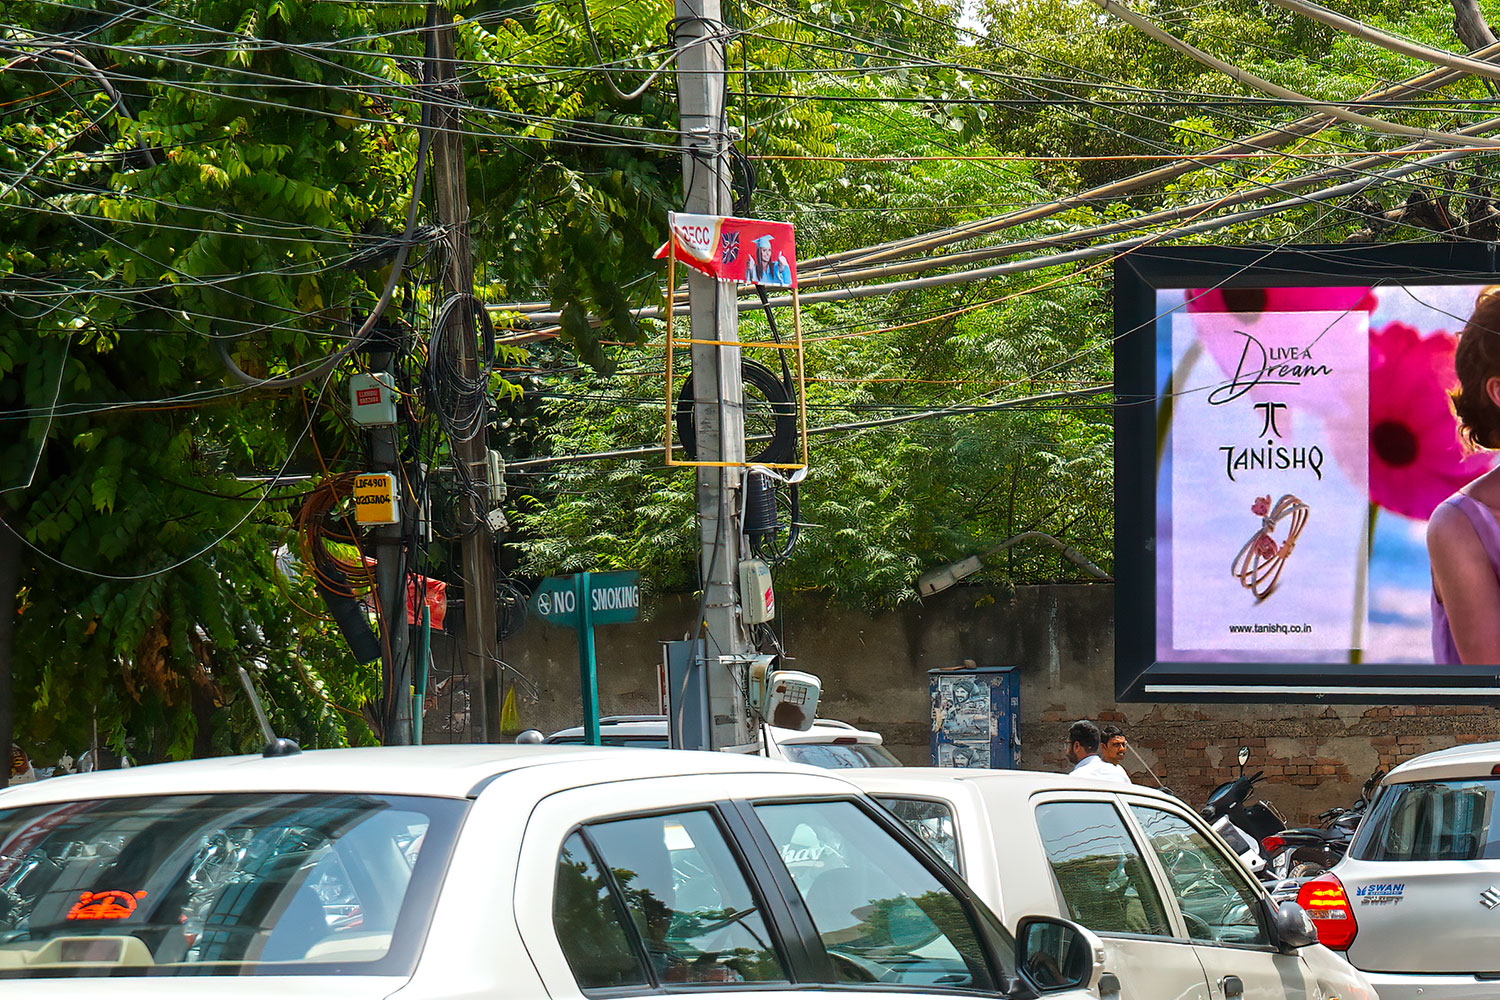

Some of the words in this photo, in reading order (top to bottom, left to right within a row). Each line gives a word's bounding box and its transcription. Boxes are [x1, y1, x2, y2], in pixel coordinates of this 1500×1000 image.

[1269, 347, 1299, 360] LIVE
[1301, 347, 1312, 360] A
[1208, 330, 1332, 405] Dream
[554, 590, 575, 613] NO
[591, 585, 639, 611] SMOKING
[1229, 623, 1312, 634] www.tanishq.co.in
[780, 843, 825, 862] hav
[1368, 883, 1405, 892] SWANI
